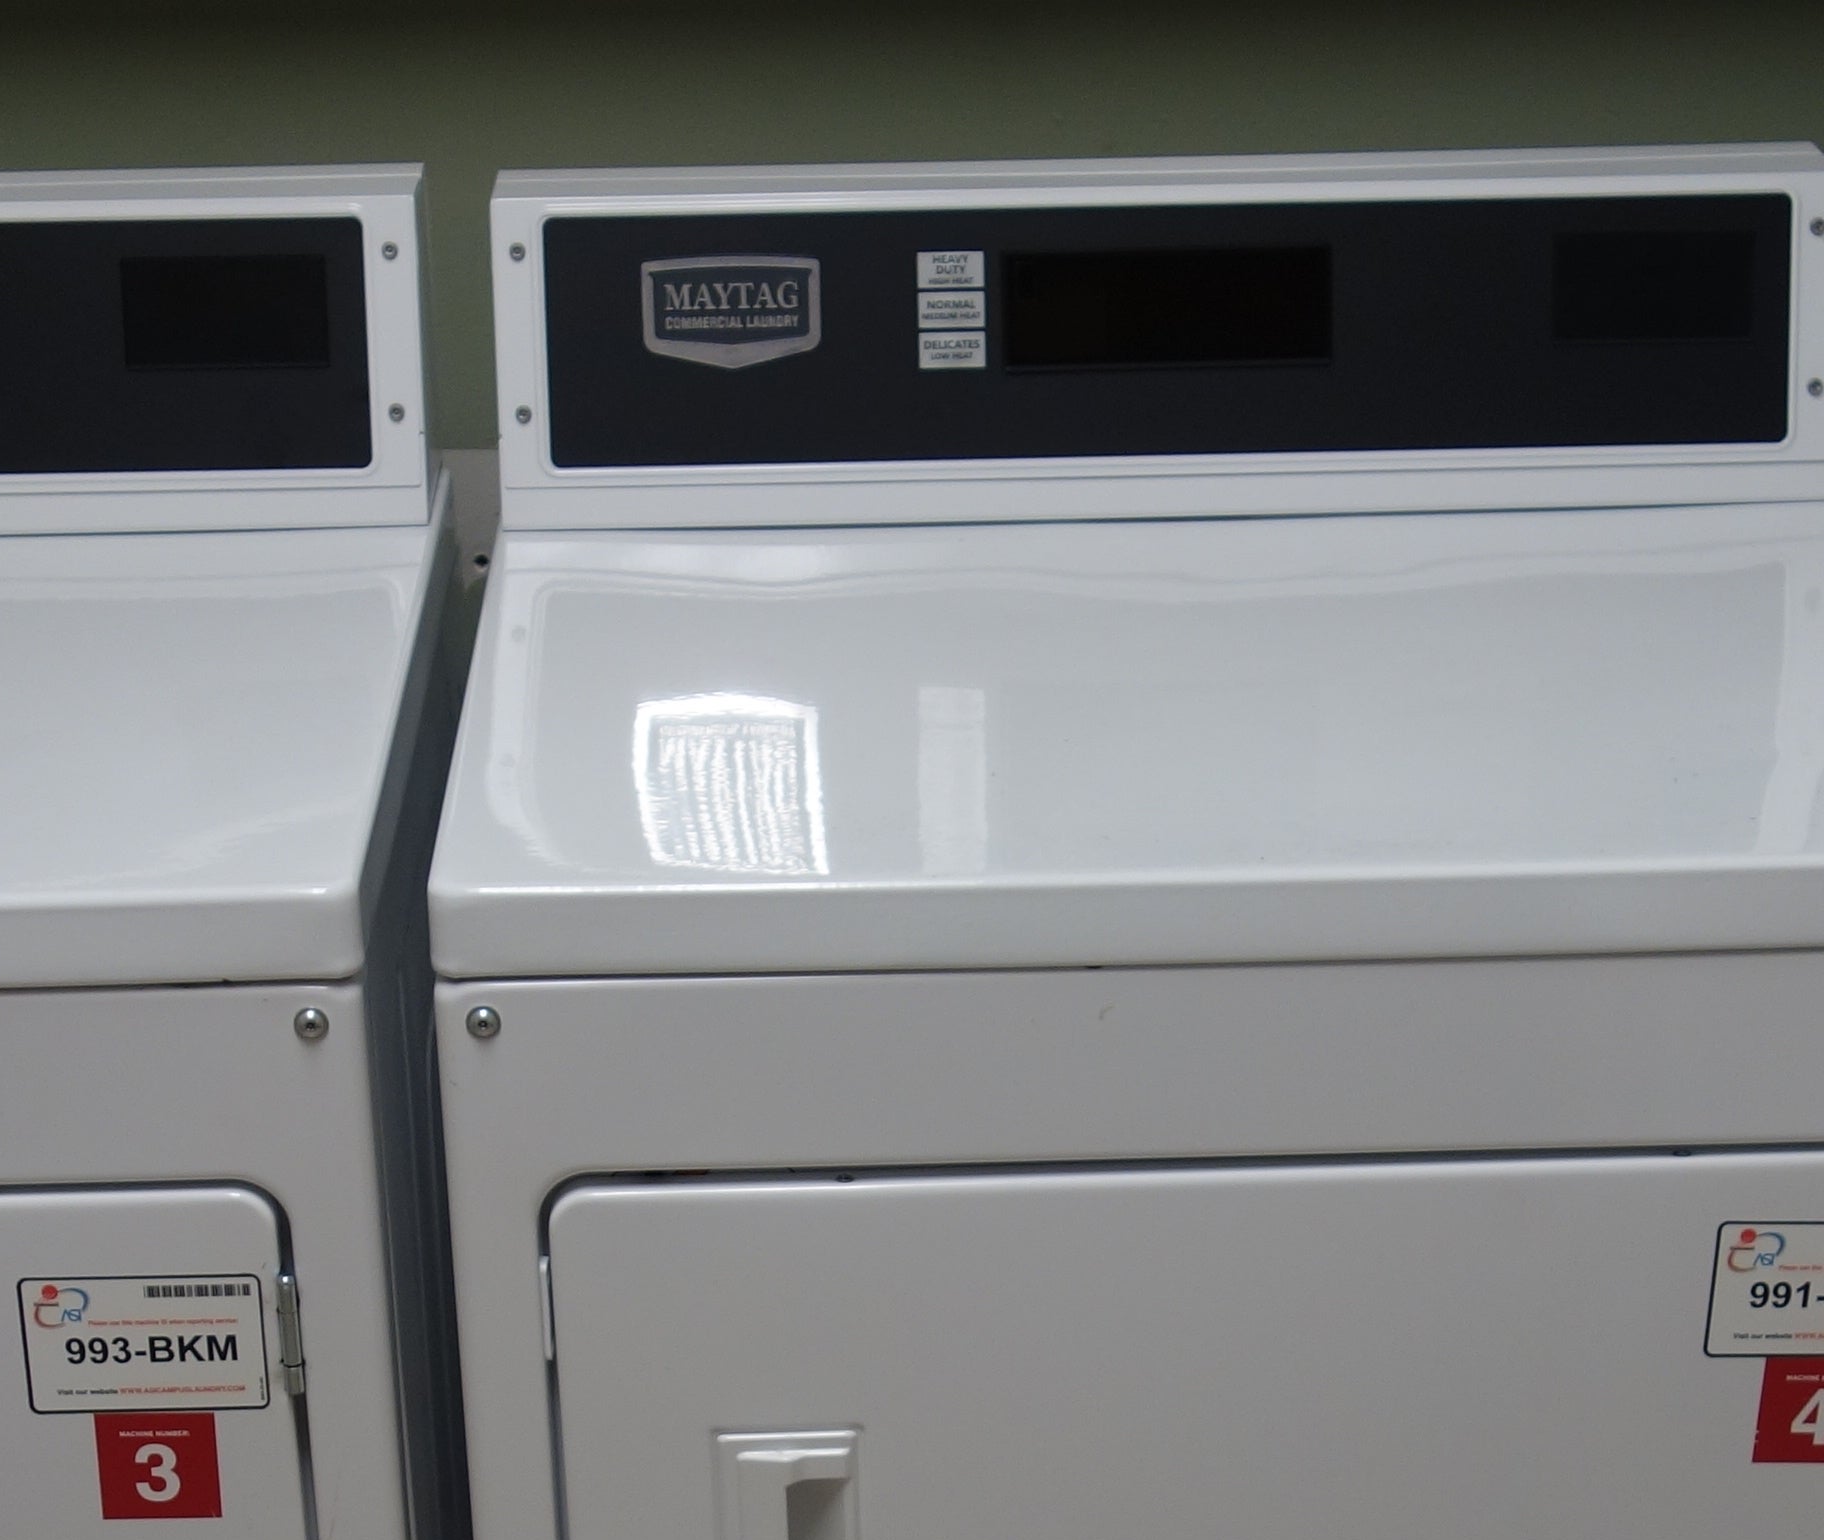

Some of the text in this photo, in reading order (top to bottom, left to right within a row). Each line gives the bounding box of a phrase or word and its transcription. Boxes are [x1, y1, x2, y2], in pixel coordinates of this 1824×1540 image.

[932, 254, 968, 264] HEAVY
[936, 265, 966, 274] DUTY
[663, 281, 800, 311] MAYTAG
[927, 300, 976, 309] NORMAL
[665, 314, 799, 330] COMMERCIAL LAUNDRY
[924, 340, 980, 349] DELICATES
[65, 1334, 238, 1365] 993-BKM
[134, 1443, 181, 1502] 3
